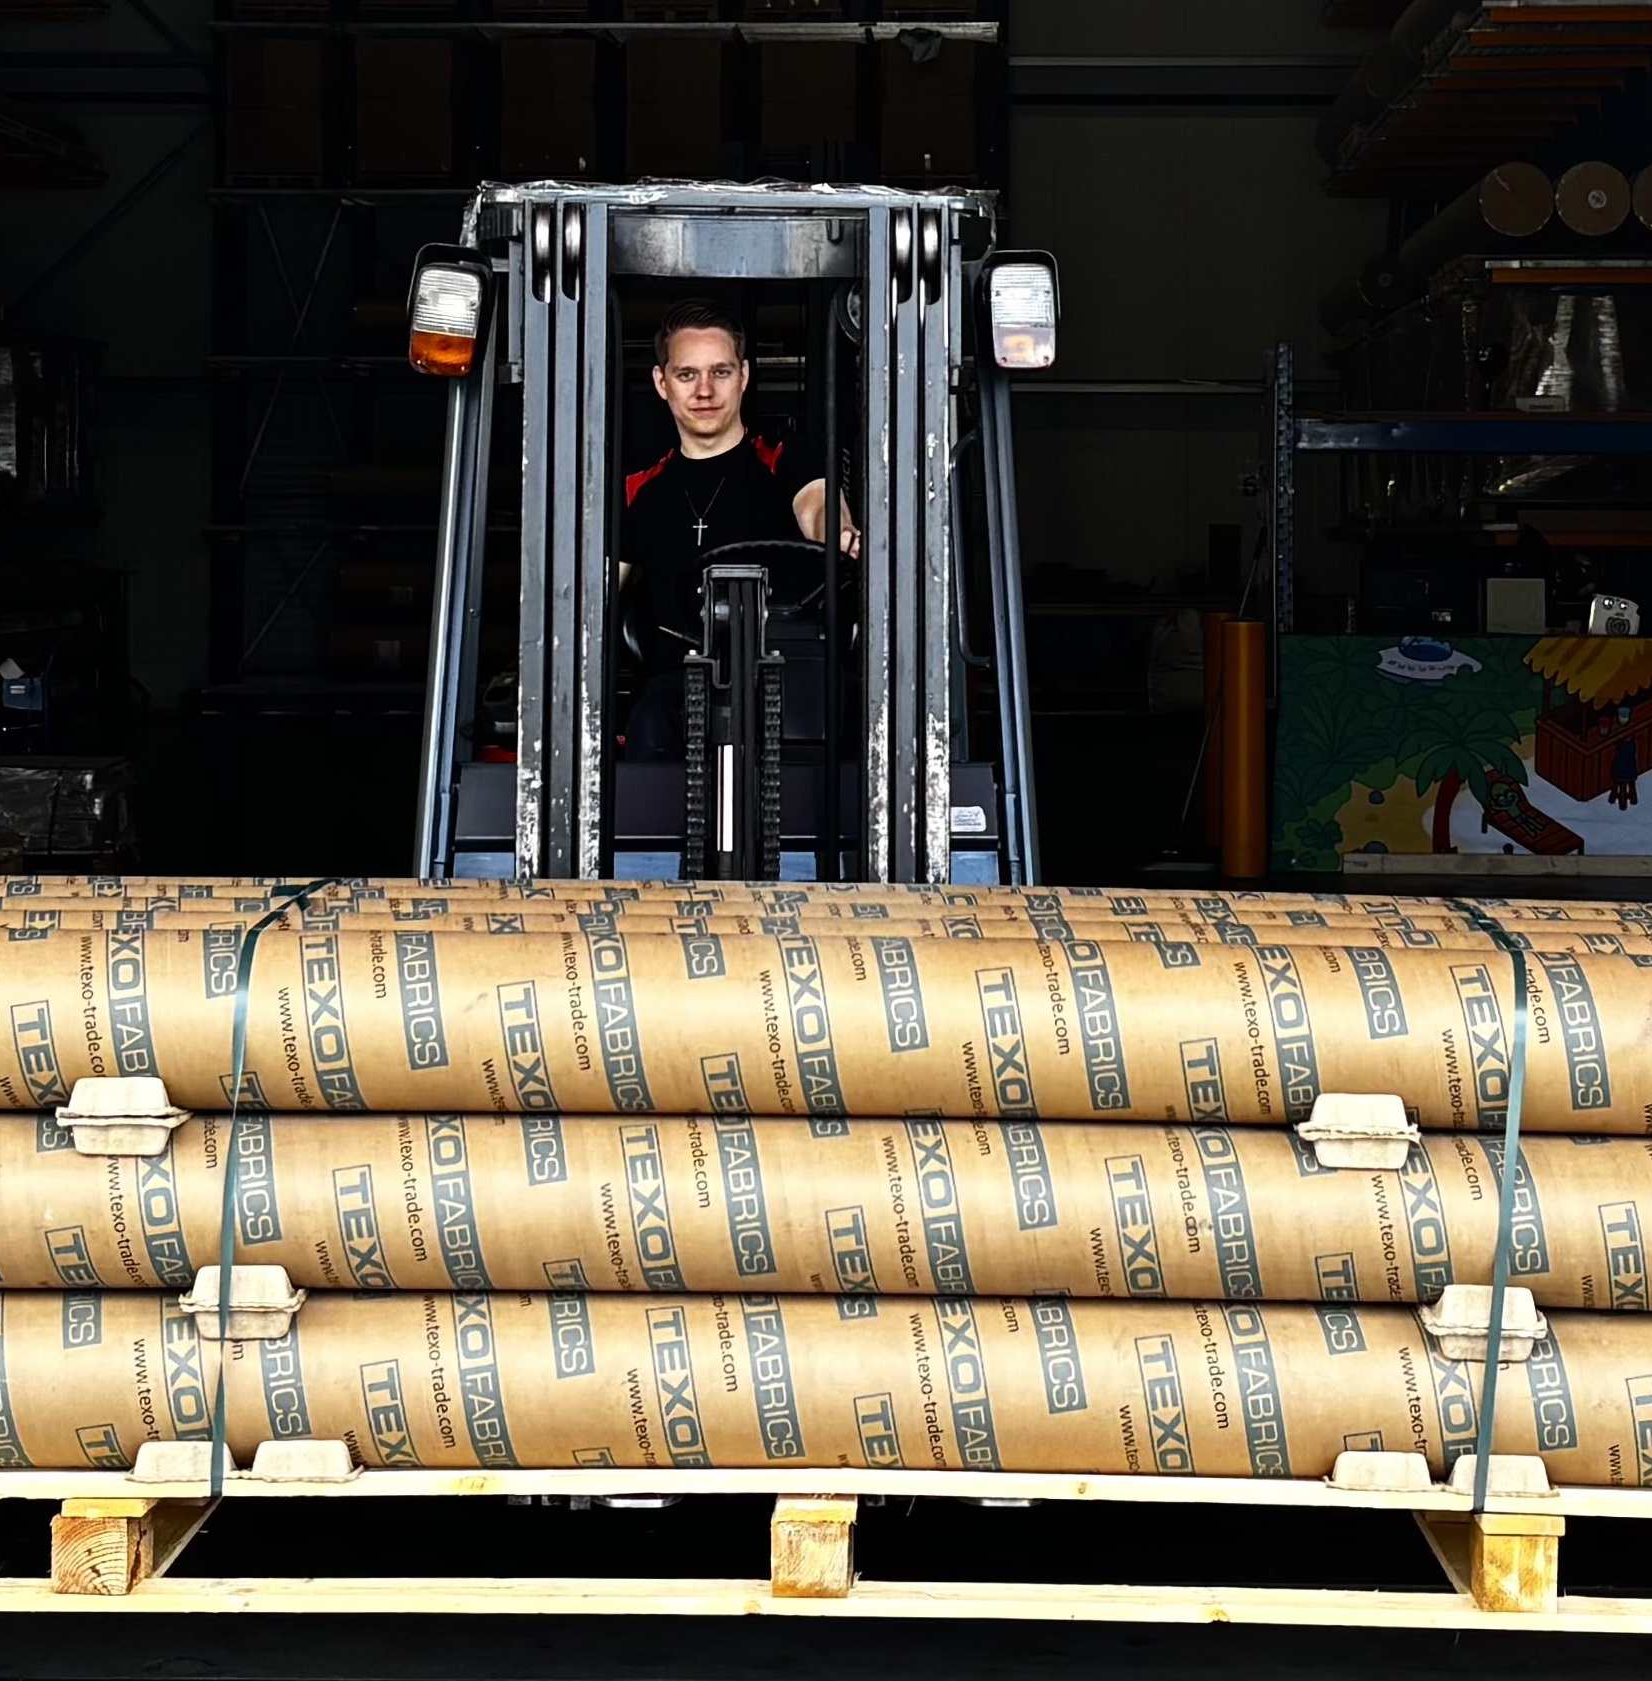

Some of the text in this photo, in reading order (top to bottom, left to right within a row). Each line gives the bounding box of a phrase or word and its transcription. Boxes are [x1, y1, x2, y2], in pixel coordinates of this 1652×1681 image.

[304, 936, 345, 1072] TEXO
[882, 938, 925, 1049] ABRICS
[982, 972, 1034, 1112] TEXO
[1077, 968, 1126, 1112] FABRICS
[1235, 962, 1271, 1114] www.texo-trade.com
[1260, 948, 1304, 1031] EXO
[1356, 950, 1402, 1034] BRICS
[1456, 968, 1510, 1104] TEXO
[1551, 966, 1605, 1108] FABRICS
[17, 1006, 65, 1100] TEX
[504, 986, 551, 1112] TEXO
[1186, 1045, 1233, 1122] TEX
[141, 1157, 177, 1224] XO
[430, 1116, 466, 1168] XO
[530, 1117, 561, 1185] RICS
[624, 1126, 673, 1265] TEXO
[910, 1120, 953, 1211] EXO
[338, 1170, 392, 1287] TEXO
[723, 1126, 770, 1275] FABRICS
[831, 1213, 873, 1292] TEX
[1111, 1162, 1163, 1291] TEXO
[1208, 1169, 1262, 1299] FABRICS
[1404, 1152, 1451, 1259] EXO
[1603, 1207, 1643, 1311] TEX
[166, 1316, 203, 1433] EXO
[456, 1300, 493, 1361] XO
[651, 1310, 701, 1452] TEXO
[749, 1310, 802, 1460] FABRICS
[939, 1300, 983, 1395] EXO
[263, 1339, 303, 1435] BRICS
[366, 1366, 413, 1466] TEX
[860, 1400, 903, 1468] TEX
[1142, 1340, 1191, 1473] TEXO
[1436, 1360, 1478, 1436] XO
[1532, 1339, 1573, 1448] BRICS
